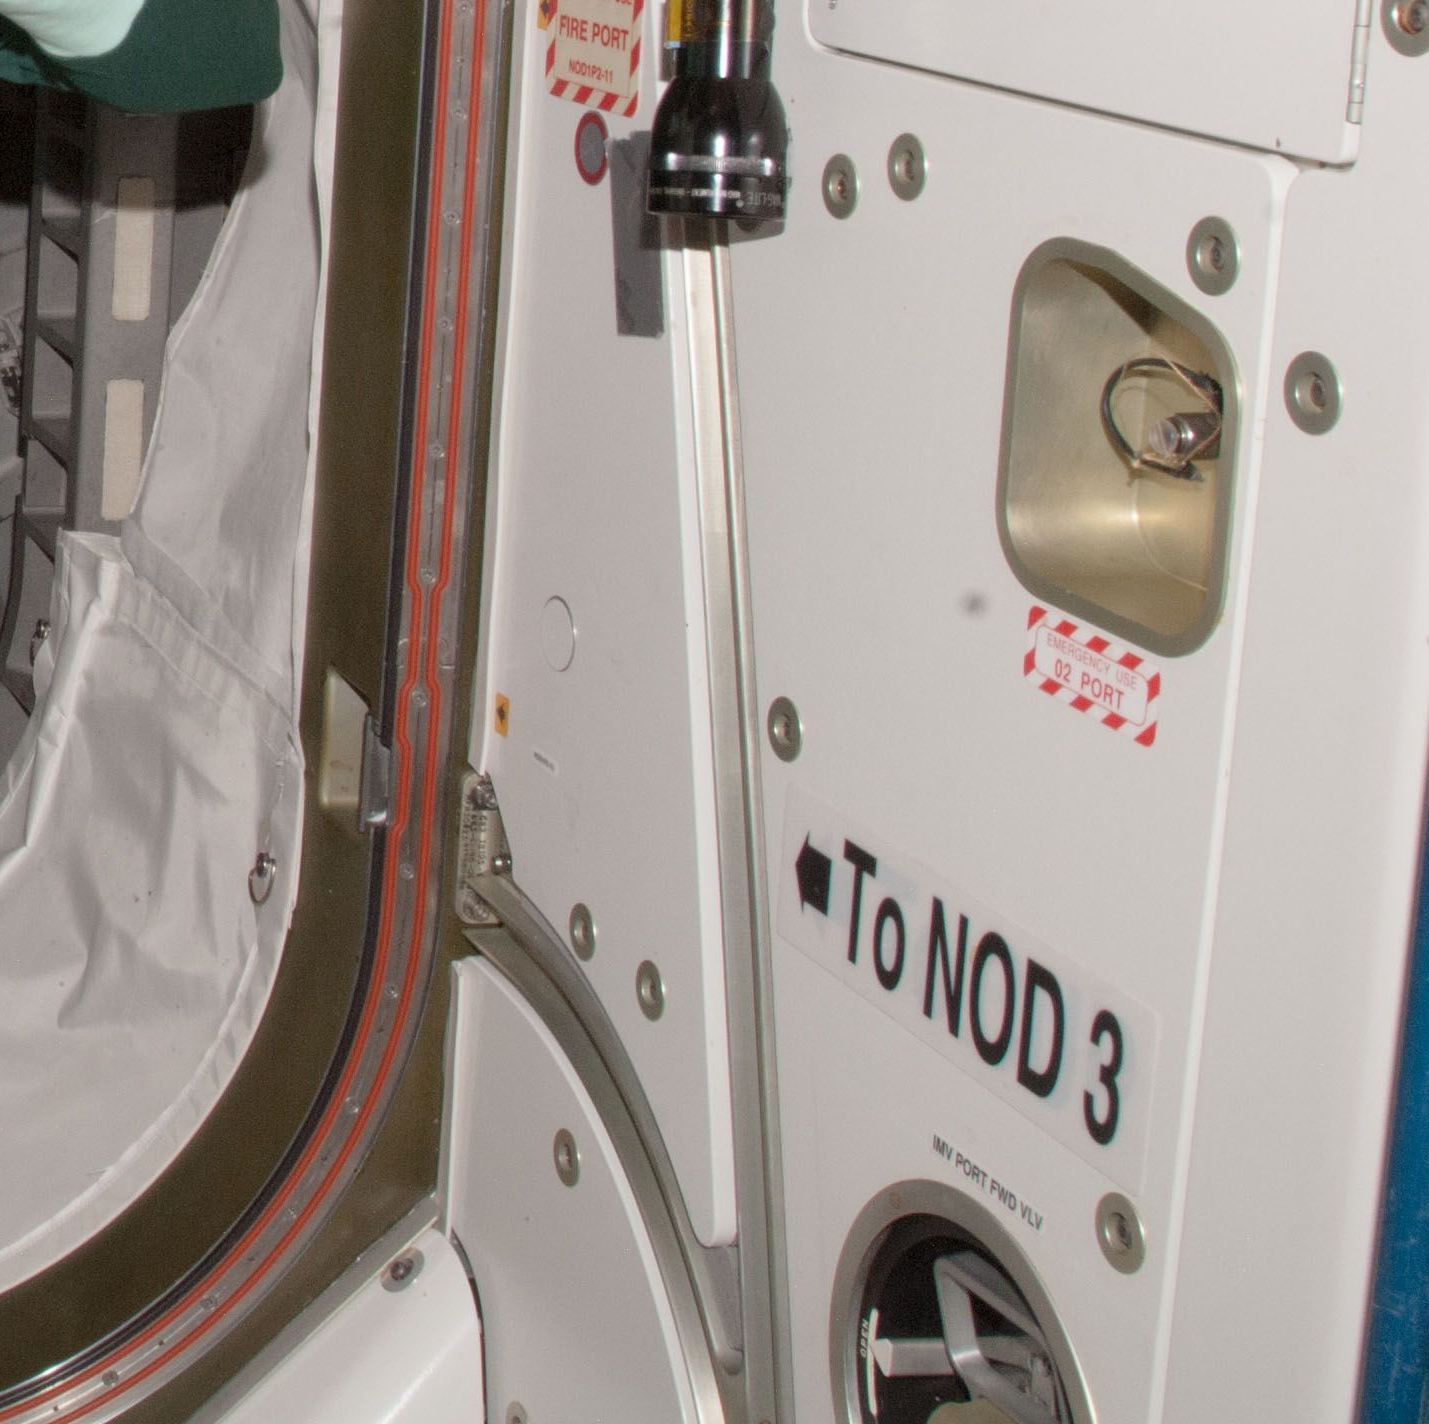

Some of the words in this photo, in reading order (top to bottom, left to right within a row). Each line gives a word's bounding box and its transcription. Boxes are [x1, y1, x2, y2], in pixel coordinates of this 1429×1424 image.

[559, 14, 588, 42] FIRE
[591, 22, 629, 51] PORT
[1047, 632, 1111, 674] EMERGENCY
[1116, 669, 1137, 690] USE
[1080, 672, 1124, 709] PORT
[843, 837, 905, 992] To
[923, 895, 1065, 1099] NOD
[1083, 1009, 1124, 1146] 3
[932, 1133, 954, 1162] IMV
[955, 1152, 988, 1191] PORT
[990, 1178, 1017, 1211] FWD
[1019, 1200, 1044, 1232] VLV
[860, 1318, 869, 1358] OPEN
